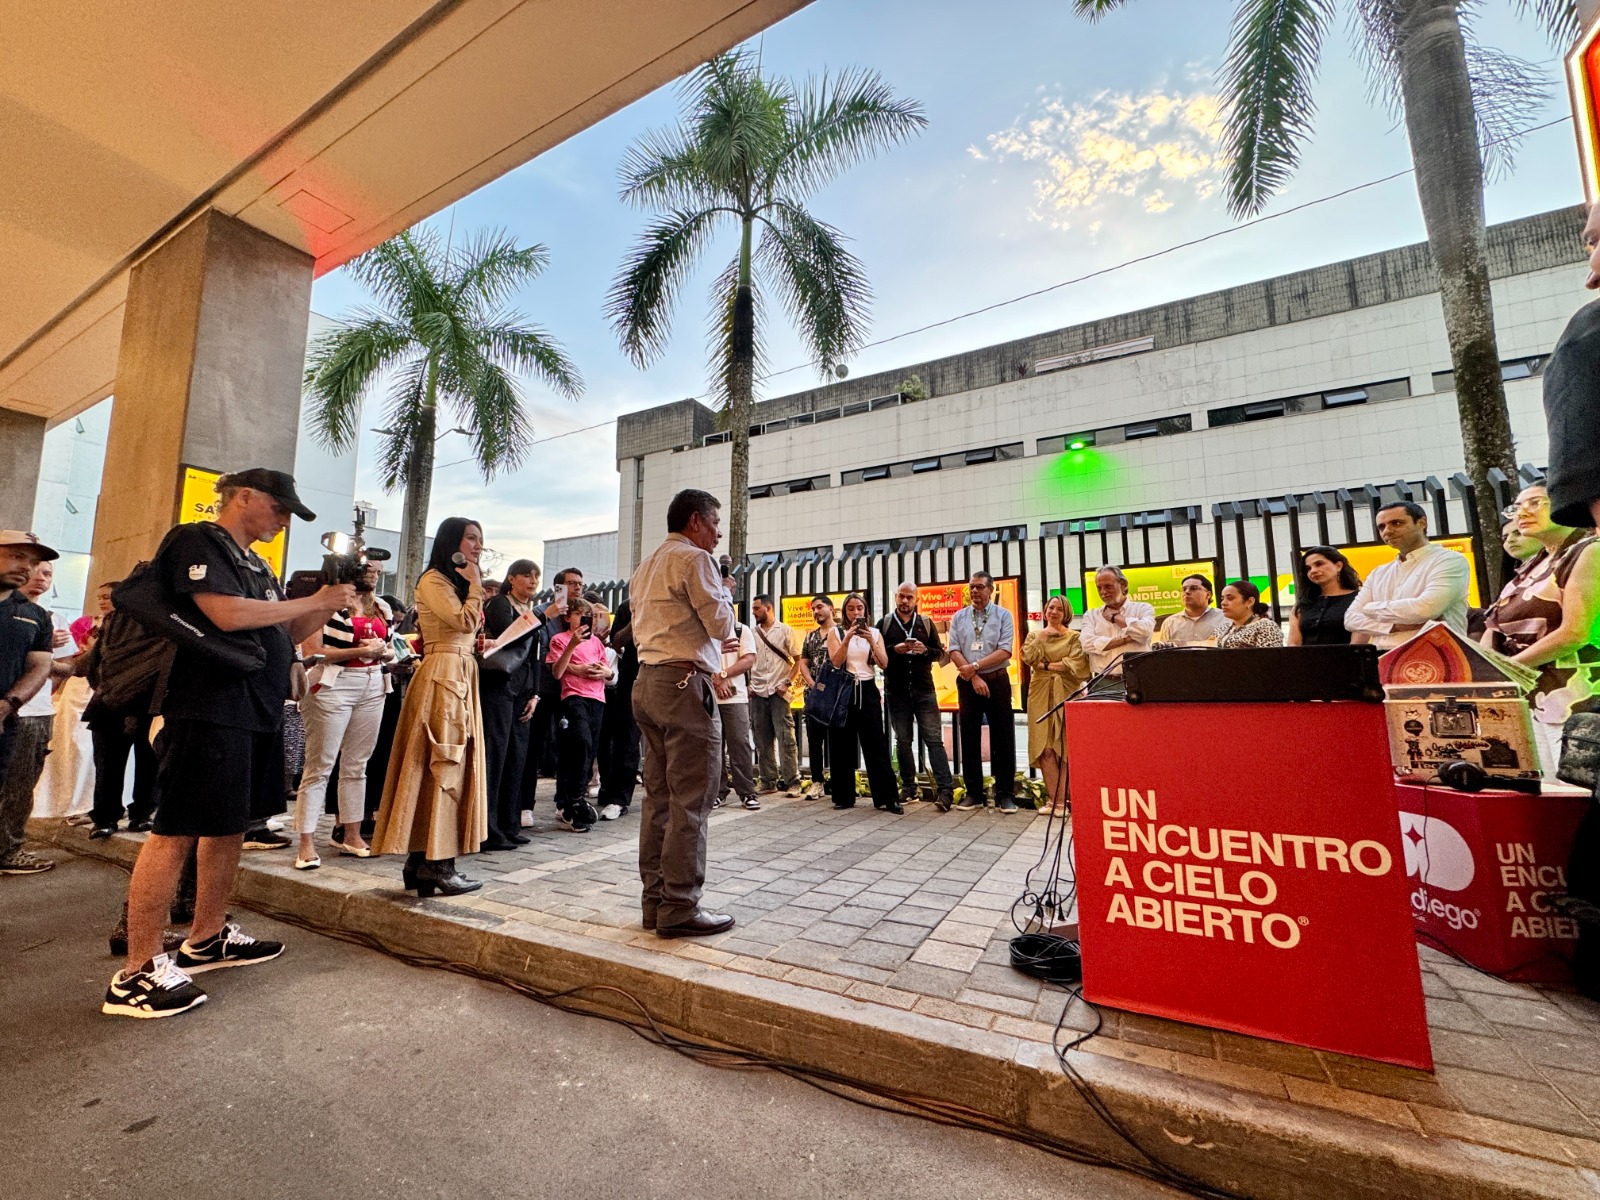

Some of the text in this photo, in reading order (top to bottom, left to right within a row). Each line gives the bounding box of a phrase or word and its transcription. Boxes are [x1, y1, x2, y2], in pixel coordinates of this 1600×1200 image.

[921, 592, 942, 601] Vive
[921, 599, 959, 609] Medellín
[1128, 590, 1181, 602] ANDIEGO
[787, 604, 804, 612] Vive
[787, 611, 813, 619] Medellí
[1100, 786, 1157, 820] UN
[1102, 819, 1392, 877] ENCUENTRO
[1495, 842, 1536, 864] UN
[1104, 856, 1278, 906] A CIELO
[1410, 887, 1478, 930] diego
[1506, 890, 1527, 913] A
